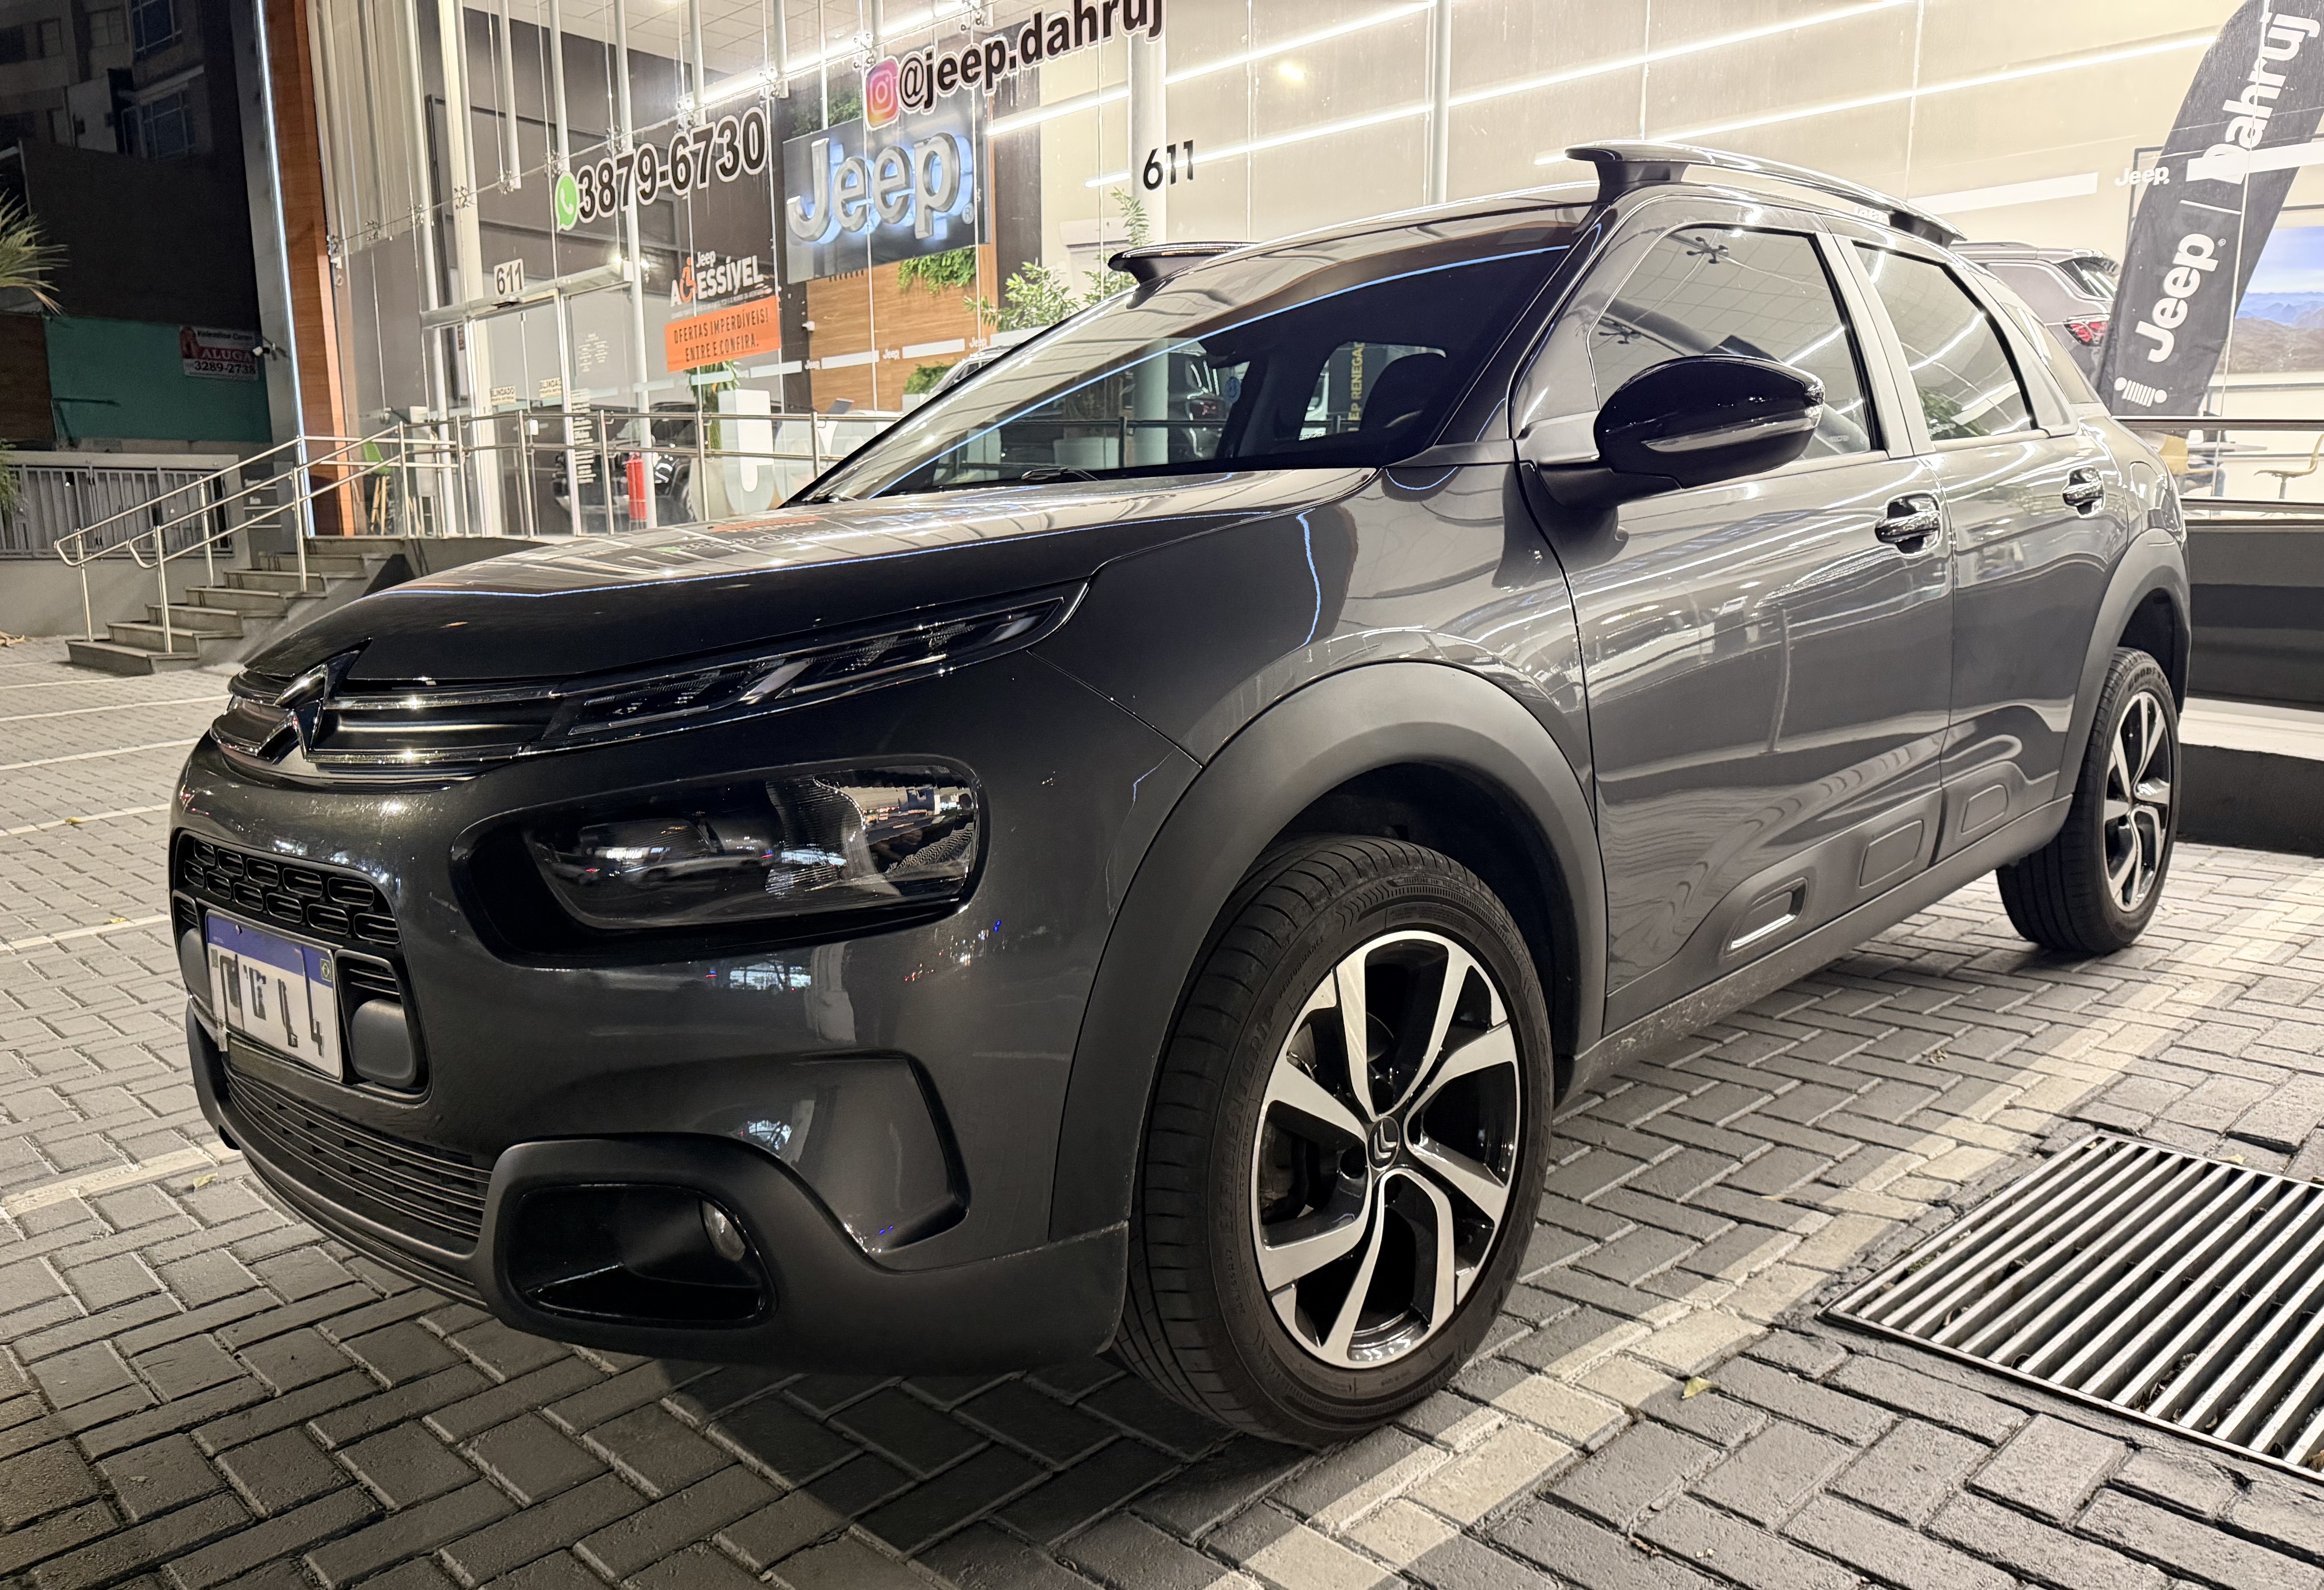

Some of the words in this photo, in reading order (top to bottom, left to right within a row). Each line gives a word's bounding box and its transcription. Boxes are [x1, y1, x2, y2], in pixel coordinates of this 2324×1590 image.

[576, 107, 767, 223] 3879-6730
[1143, 139, 1194, 190] 611
[2114, 166, 2170, 186] Jeep
[786, 132, 963, 242] Jeep
[696, 251, 716, 268] Jeep
[496, 262, 522, 295] 611
[2135, 233, 2219, 363] Jeep
[674, 322, 708, 344] OFERTAS
[710, 307, 769, 335] IMPERDÍVEIS!
[685, 340, 711, 362] ENTRE
[713, 342, 717, 356] E
[719, 333, 759, 355] CONFIRA.
